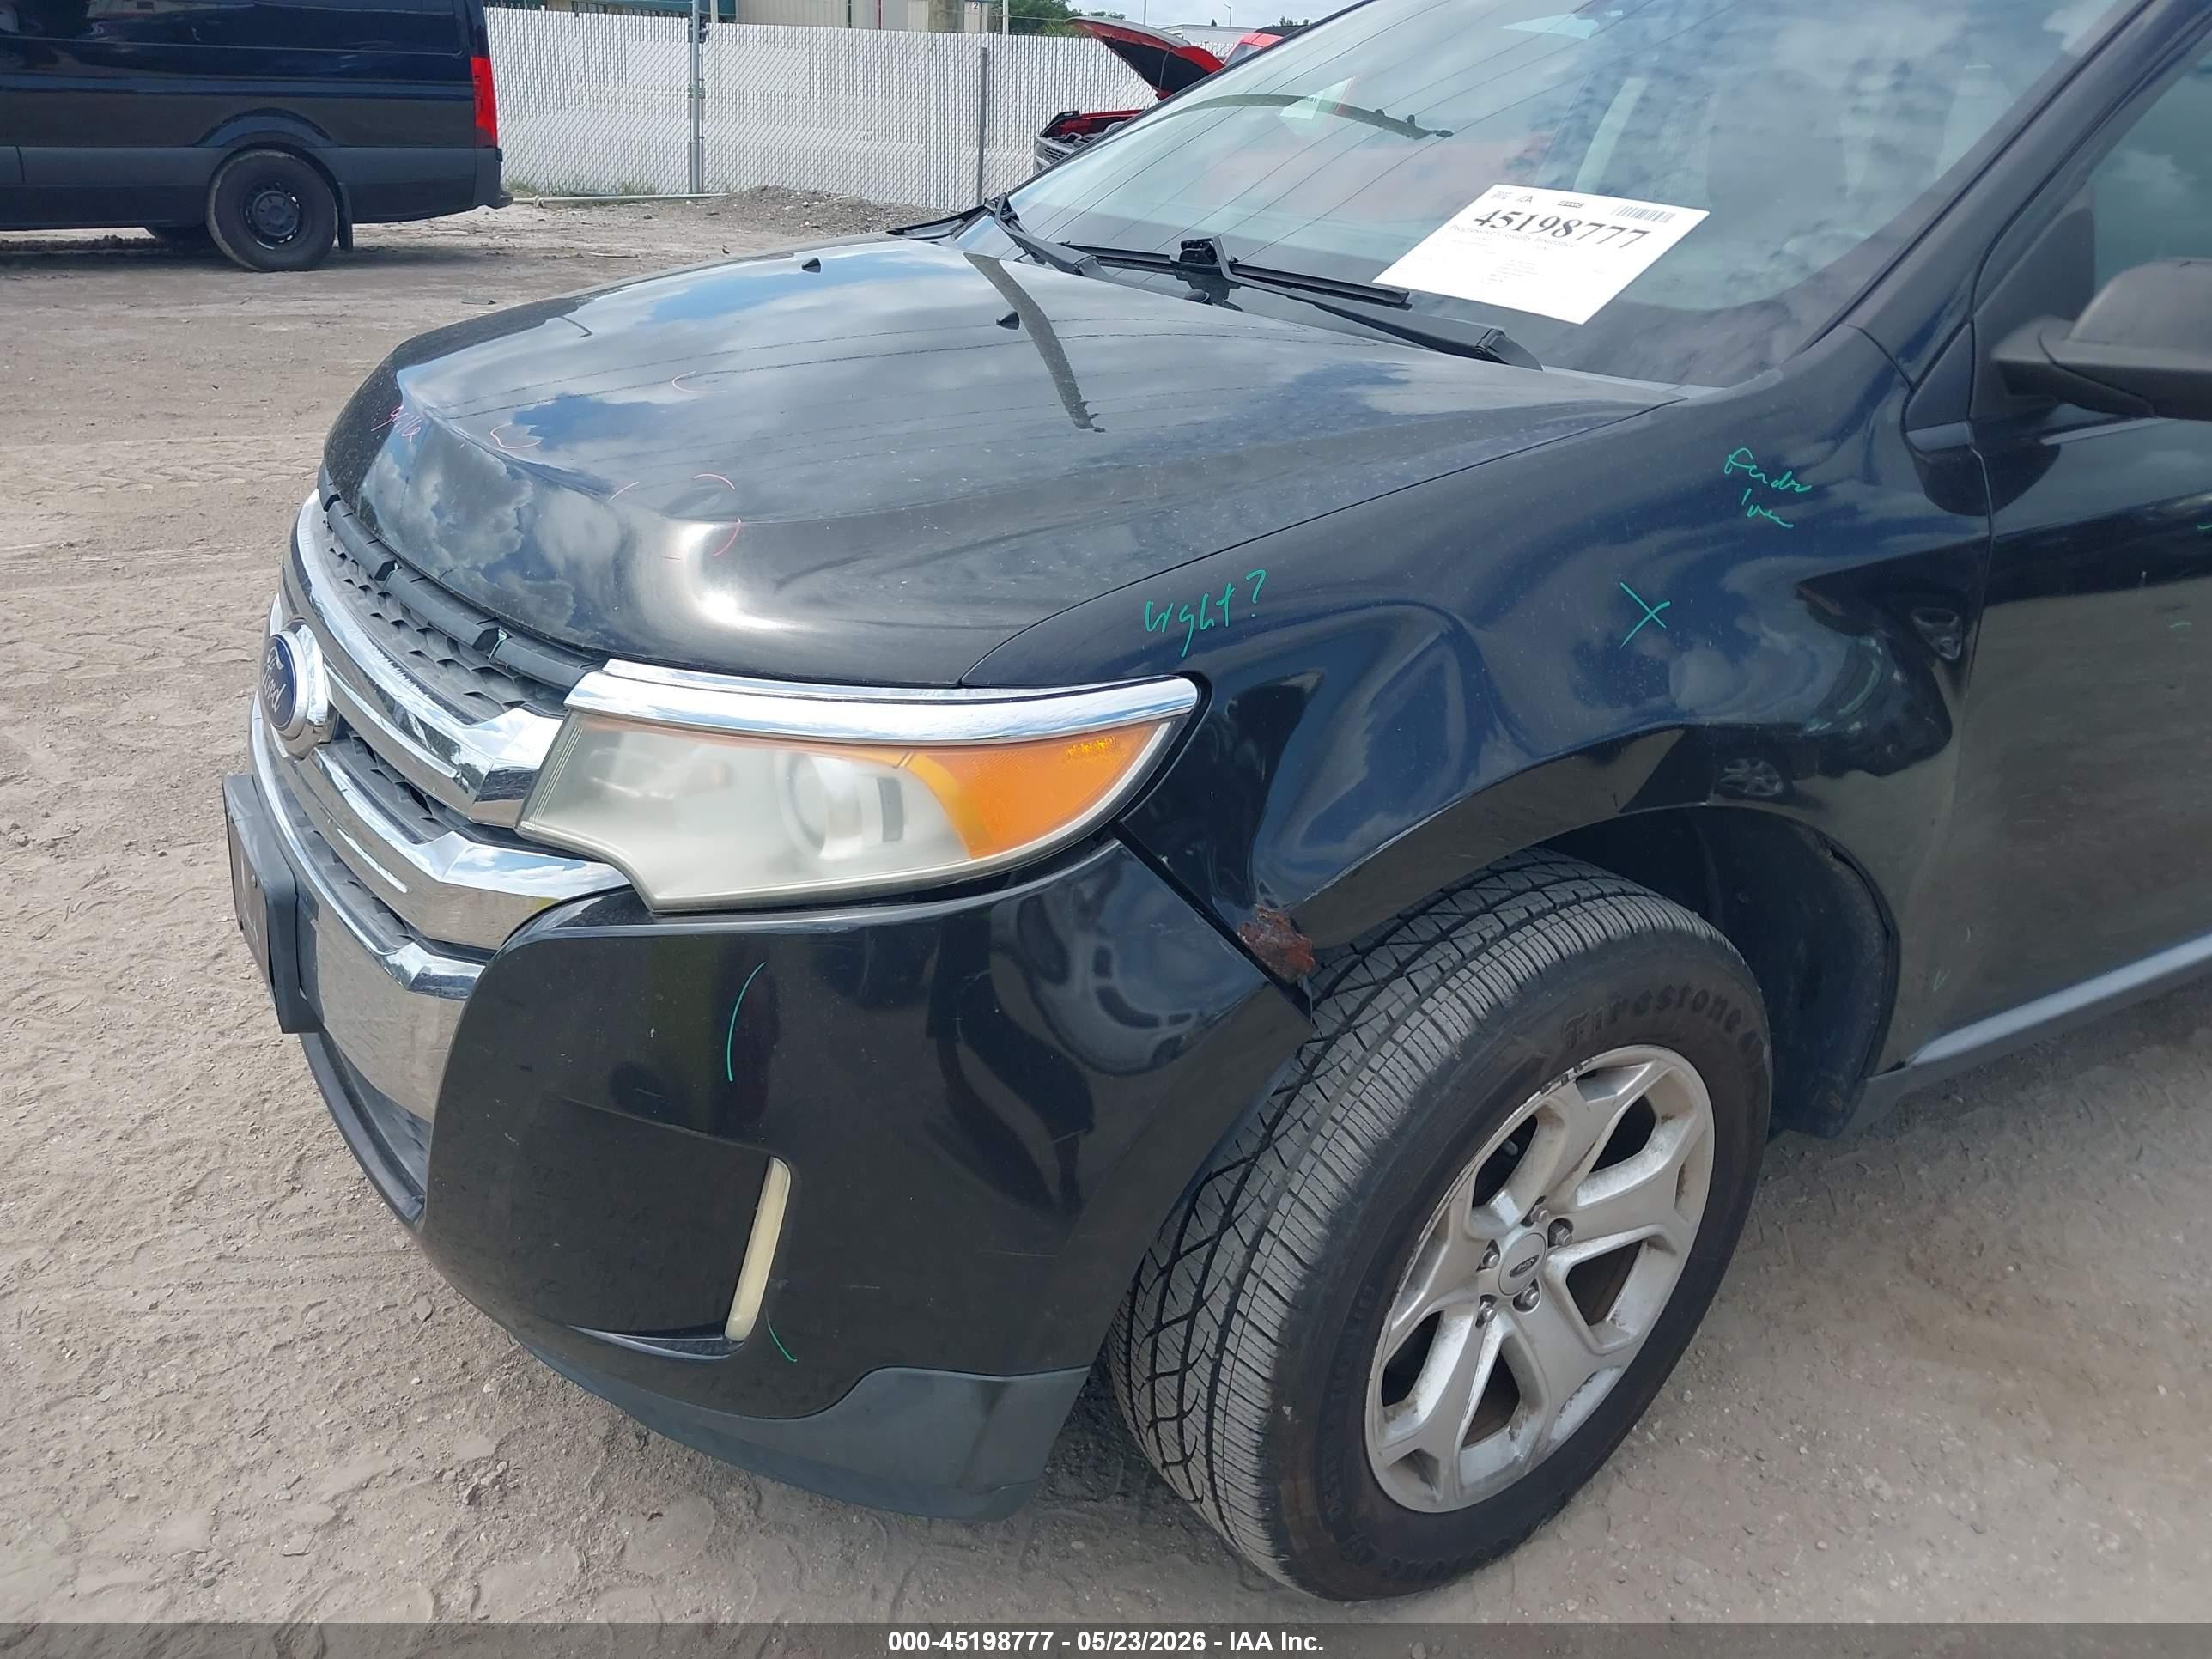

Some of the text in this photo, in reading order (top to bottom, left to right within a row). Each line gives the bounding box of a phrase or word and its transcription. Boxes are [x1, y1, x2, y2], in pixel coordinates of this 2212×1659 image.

[1473, 209, 1652, 249] 45198777
[262, 645, 288, 714] Ford
[1563, 984, 1743, 1050] Firestone
